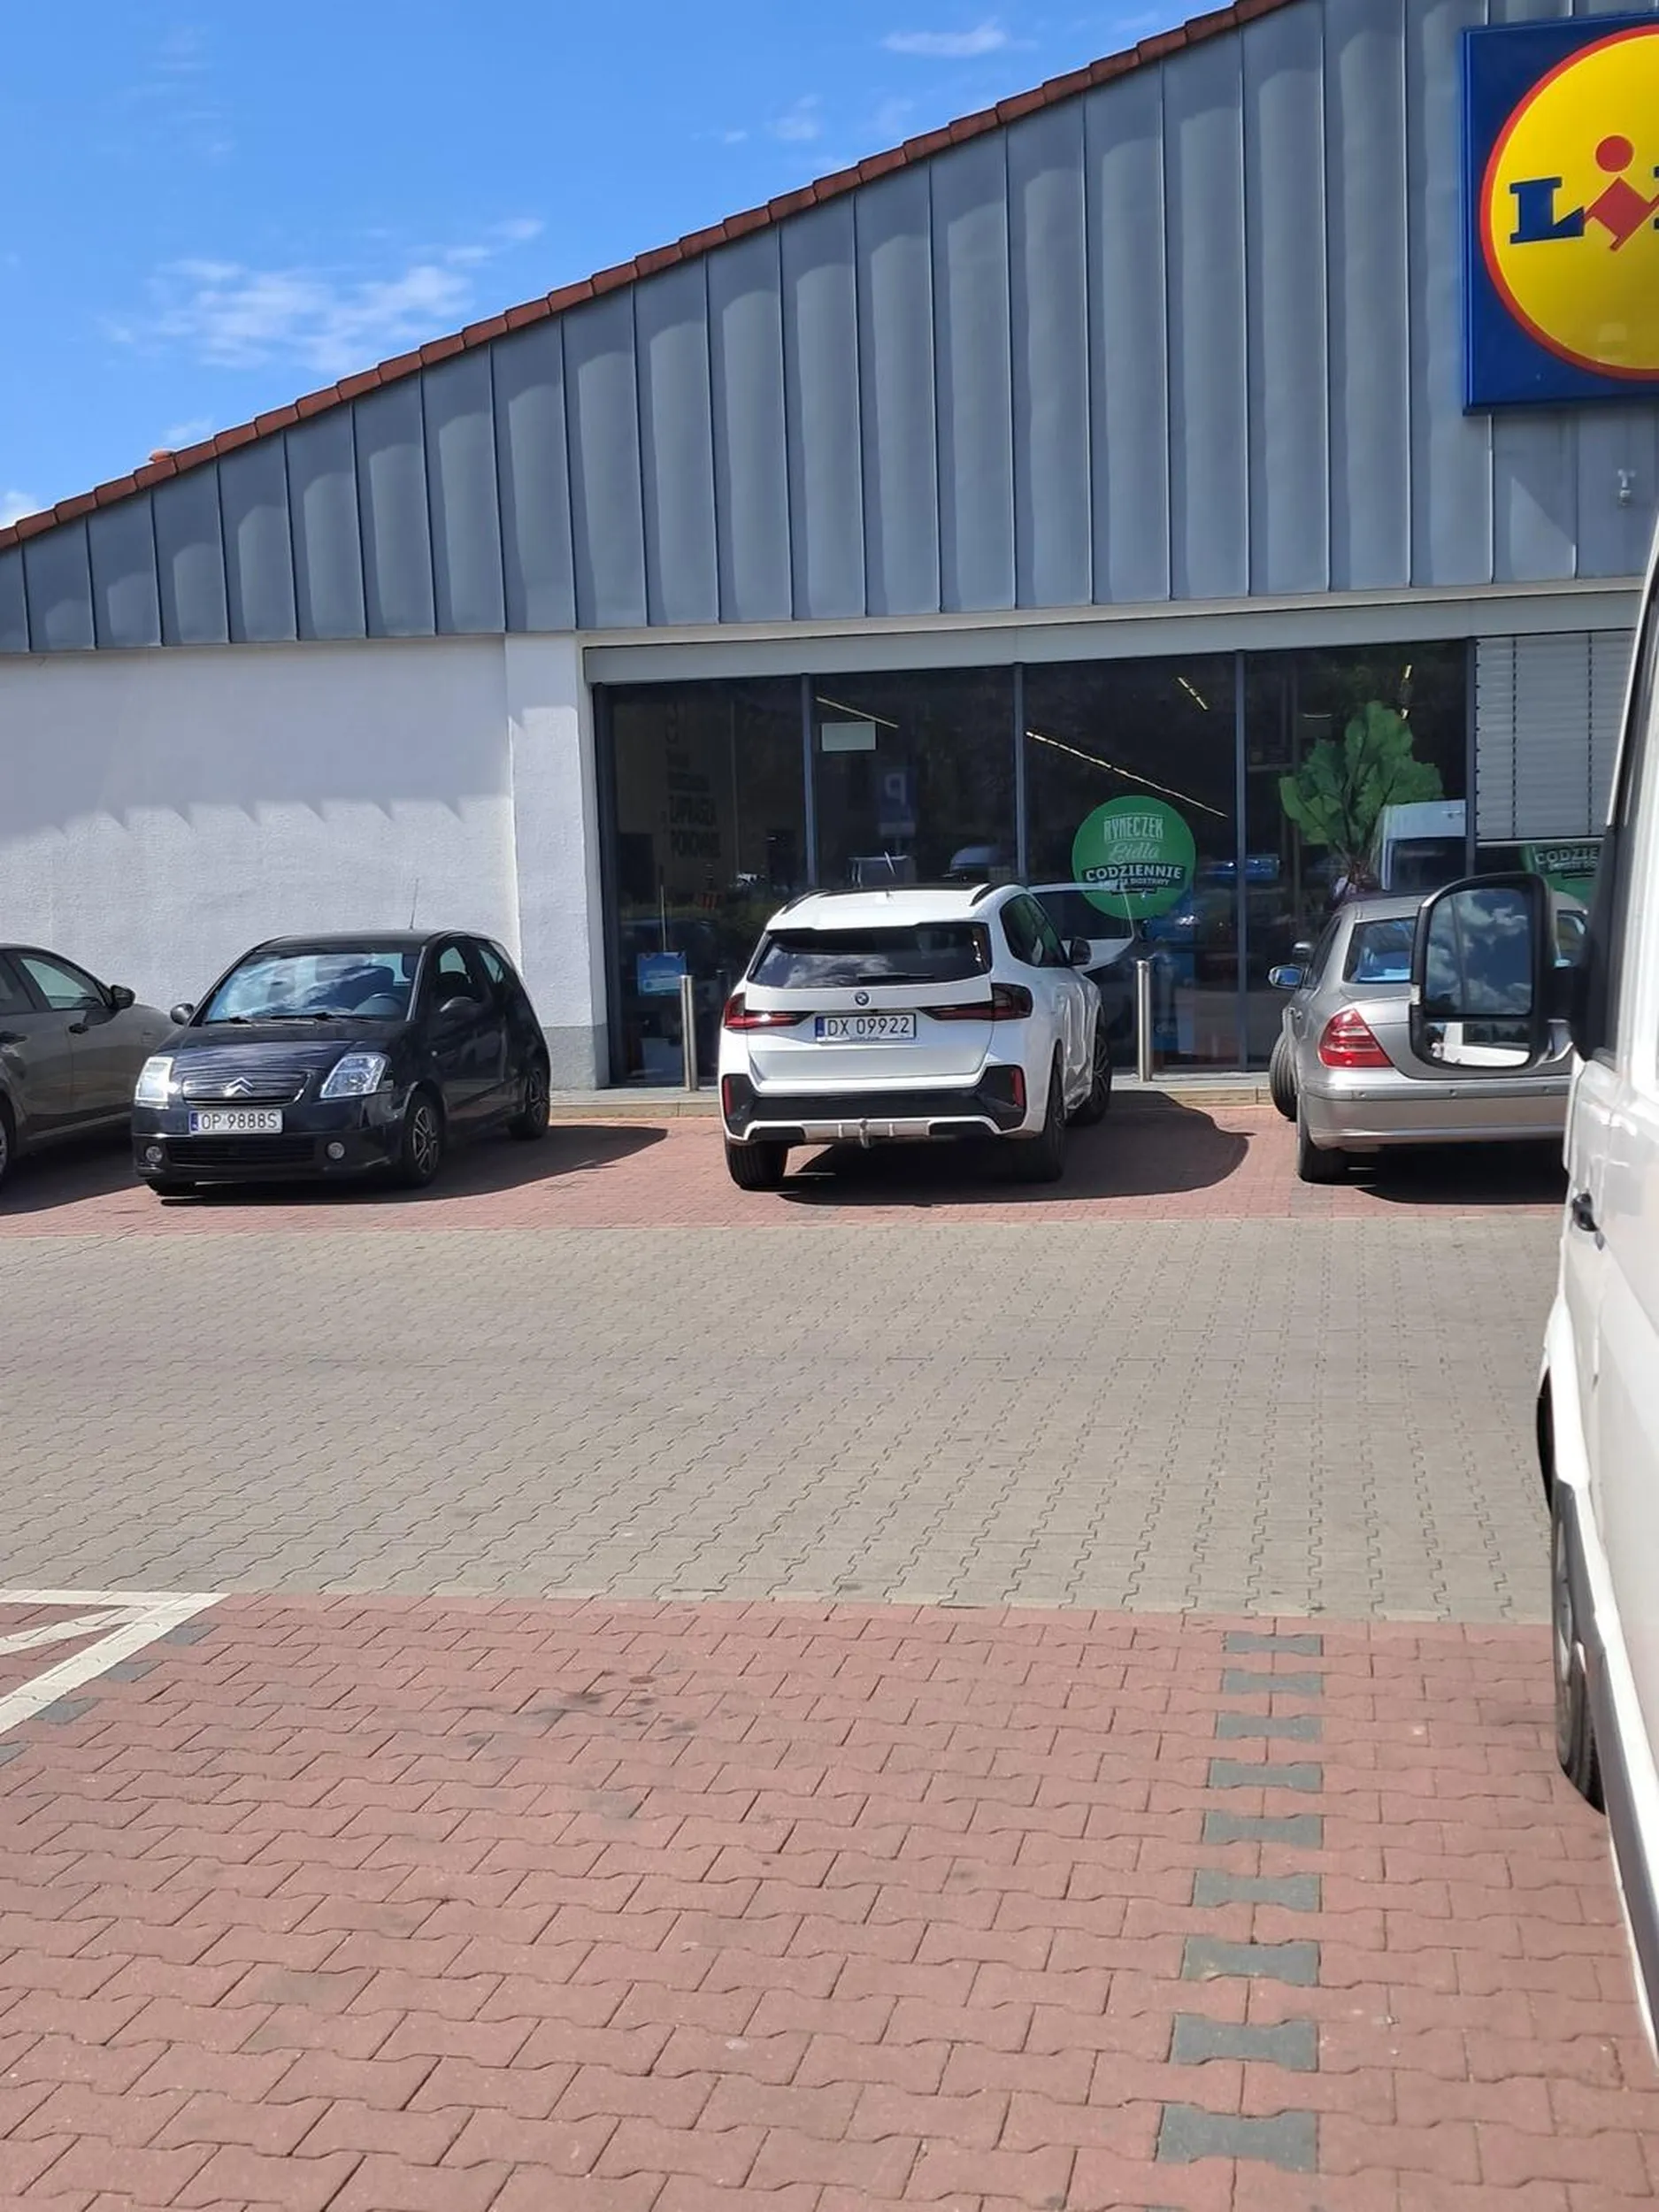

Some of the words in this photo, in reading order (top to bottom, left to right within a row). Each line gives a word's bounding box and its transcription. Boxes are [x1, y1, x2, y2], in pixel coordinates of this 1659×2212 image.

[1535, 848, 1599, 864] CODZIE
[1086, 864, 1183, 881] CODZIENNIE
[827, 1019, 849, 1036] DX
[856, 1017, 910, 1034] 09922
[202, 1114, 221, 1129] OP
[227, 1112, 277, 1128] 9888S
